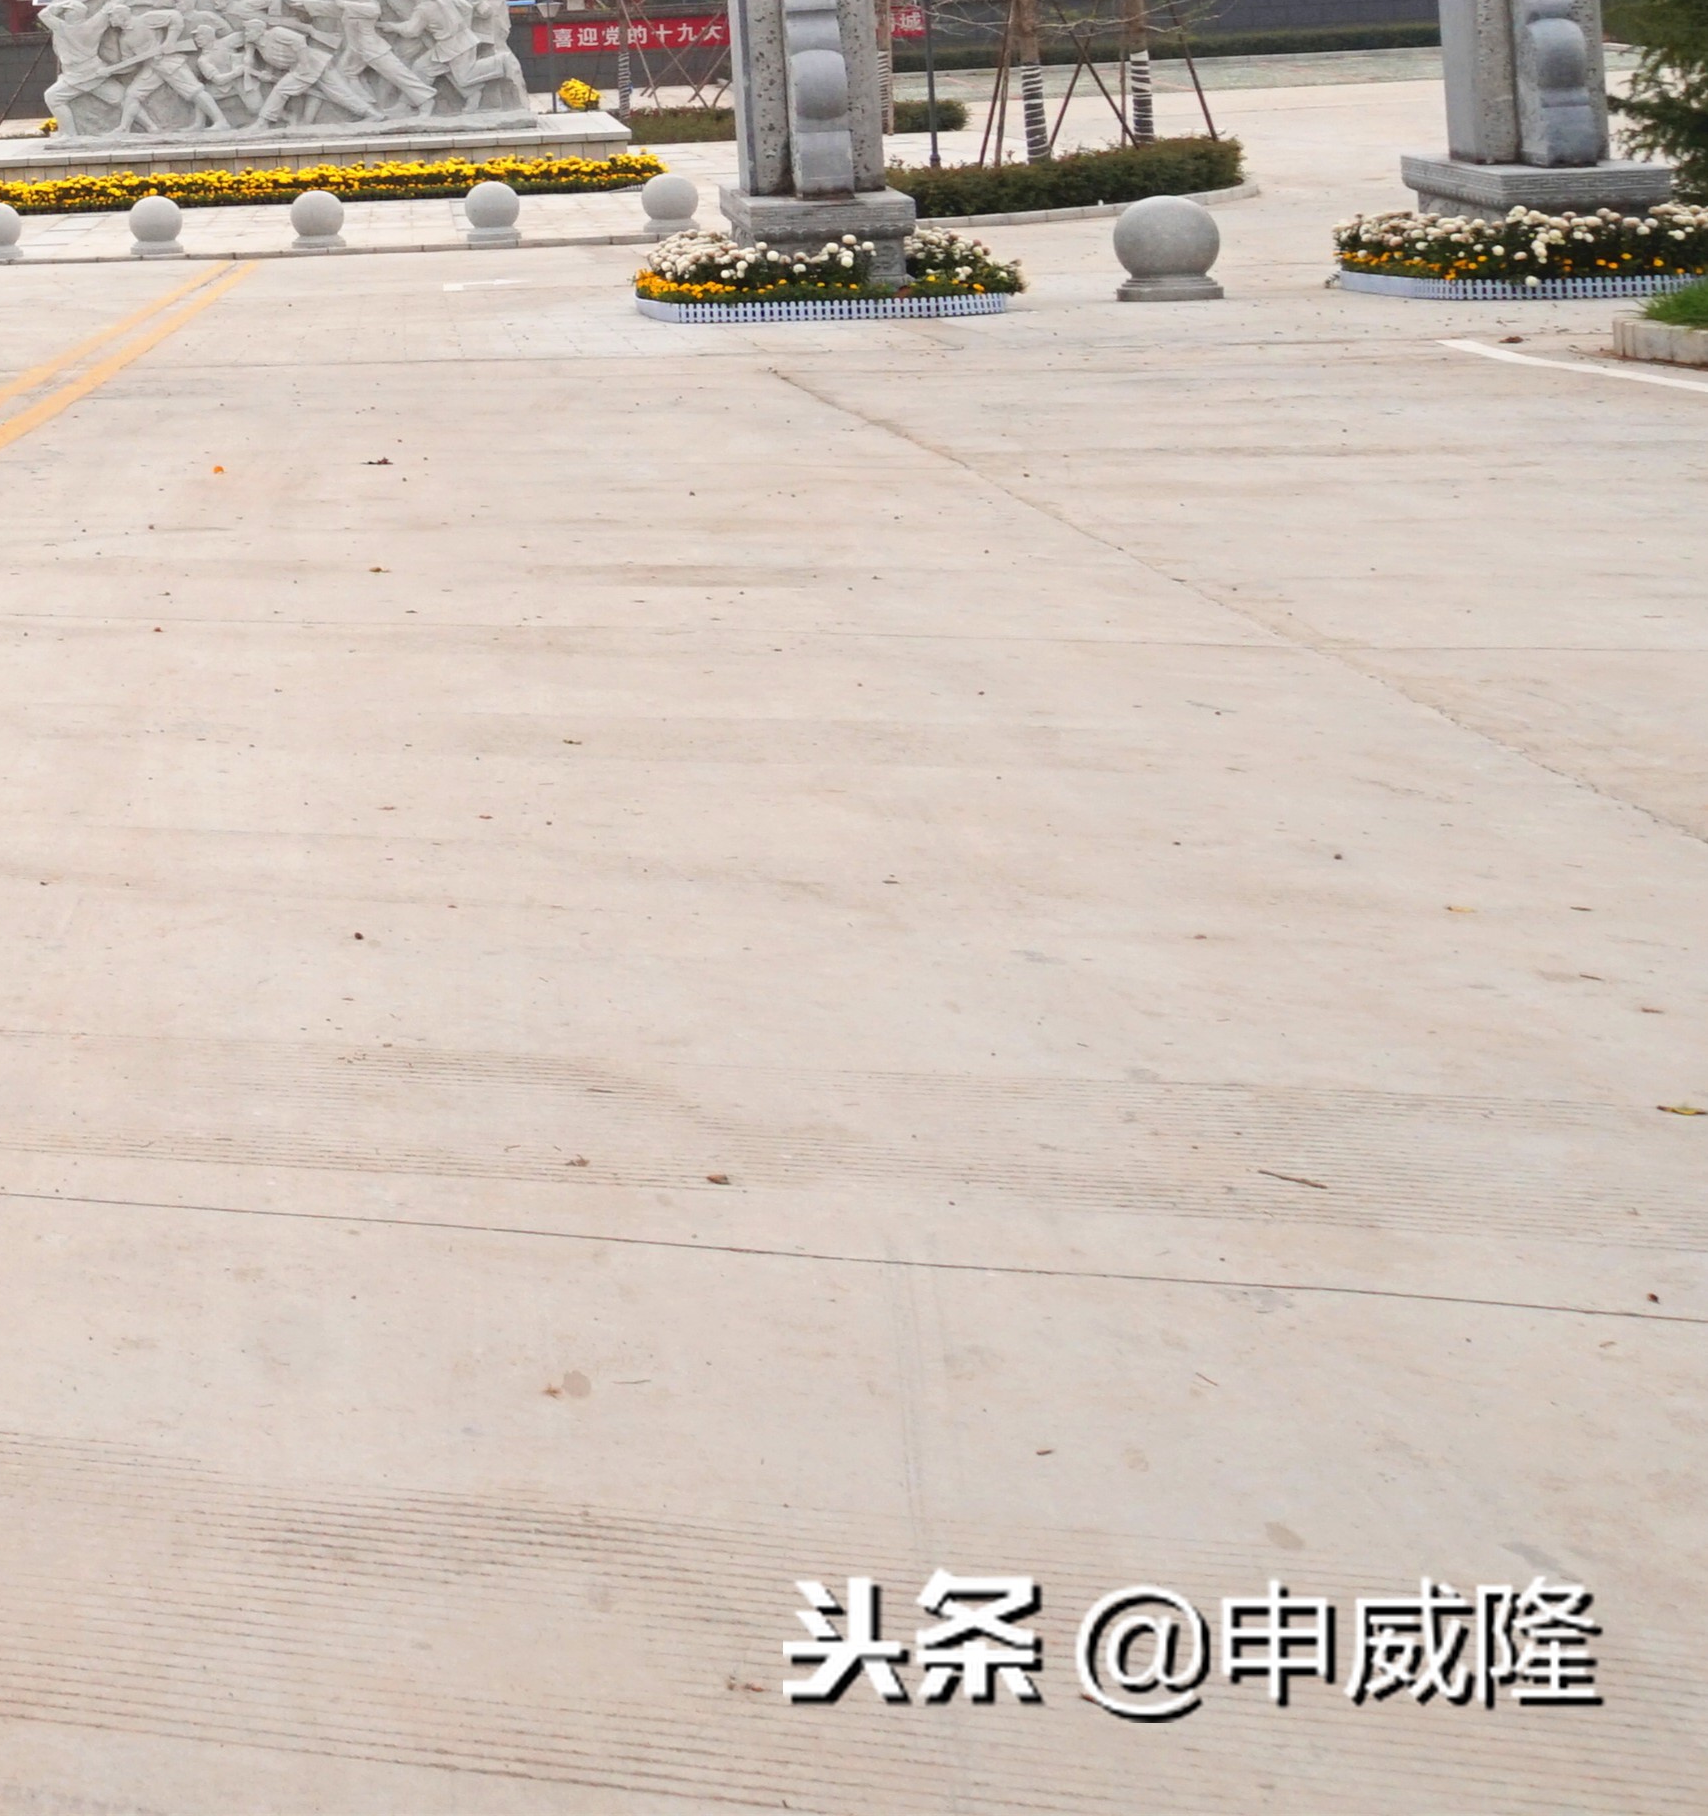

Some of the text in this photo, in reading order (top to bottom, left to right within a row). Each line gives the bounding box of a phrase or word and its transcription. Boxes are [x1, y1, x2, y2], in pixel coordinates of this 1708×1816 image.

[553, 22, 724, 49] 喜迎党的十九大
